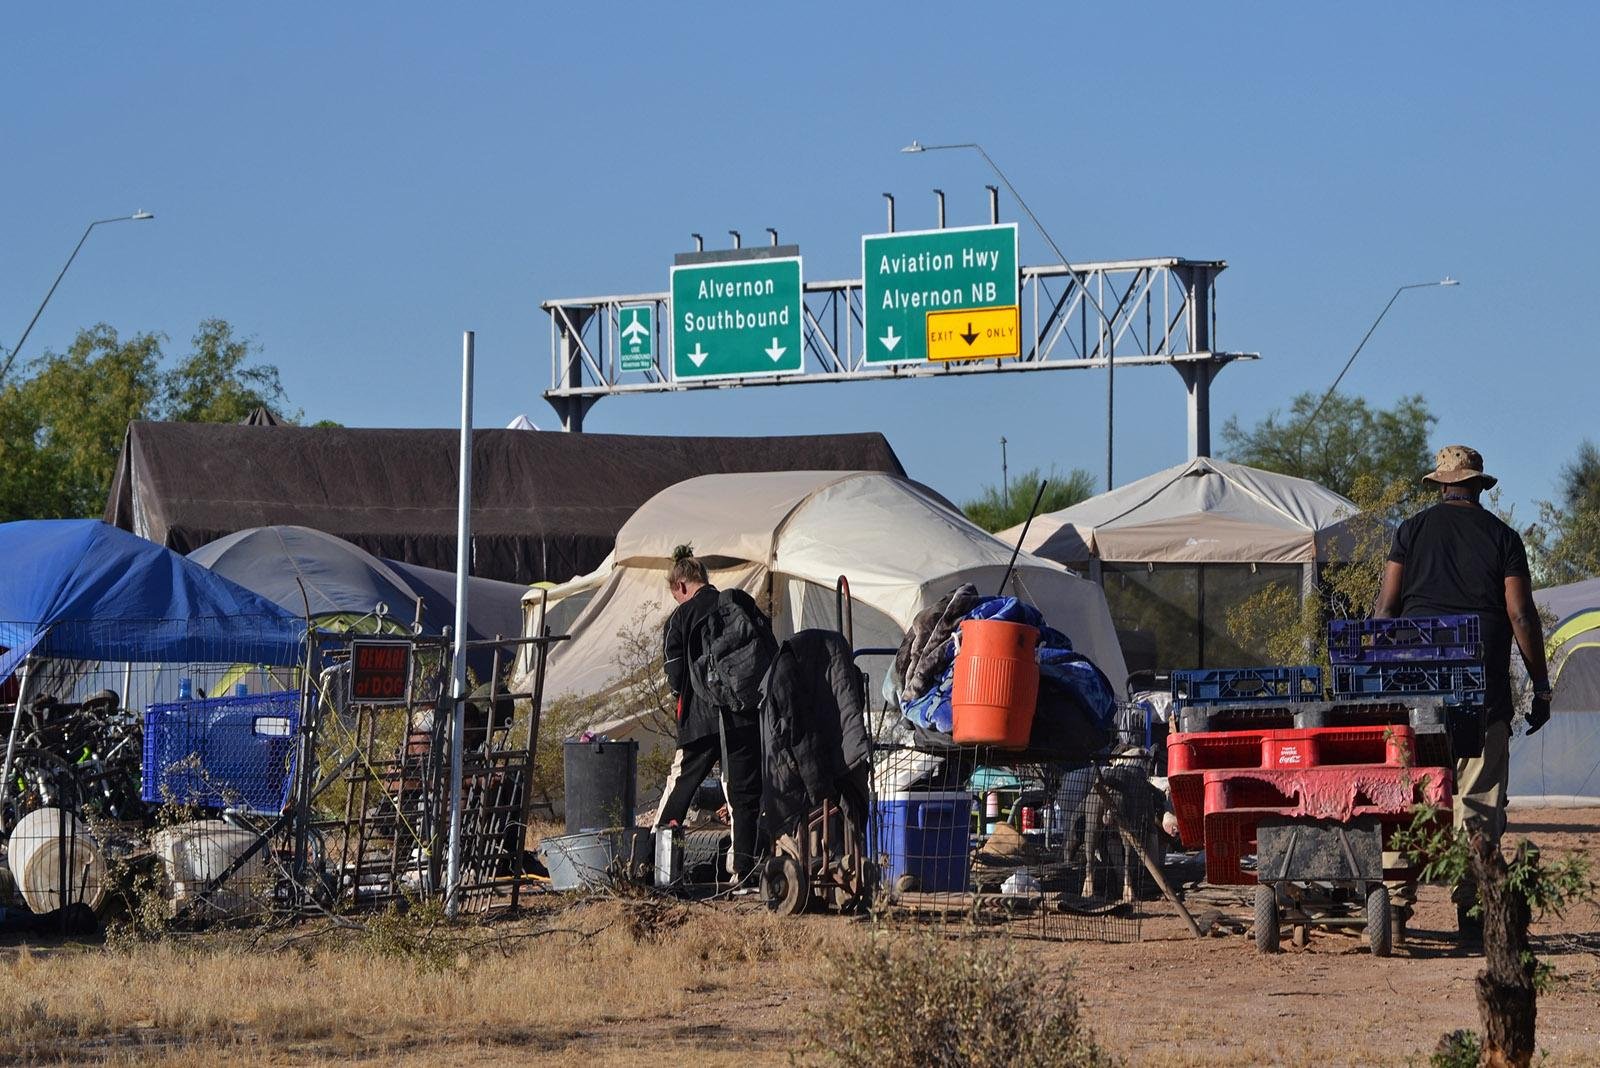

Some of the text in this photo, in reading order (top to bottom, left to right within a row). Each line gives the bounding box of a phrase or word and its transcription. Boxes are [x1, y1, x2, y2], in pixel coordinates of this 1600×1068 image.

[879, 247, 1000, 275] Aviation Hwy
[698, 278, 775, 300] Alvernon
[881, 282, 997, 310] Alvernon NB
[684, 304, 789, 333] Southbound
[931, 326, 1014, 342] EXIT ONLY
[358, 647, 406, 669] BEWARE
[371, 676, 405, 696] DOG
